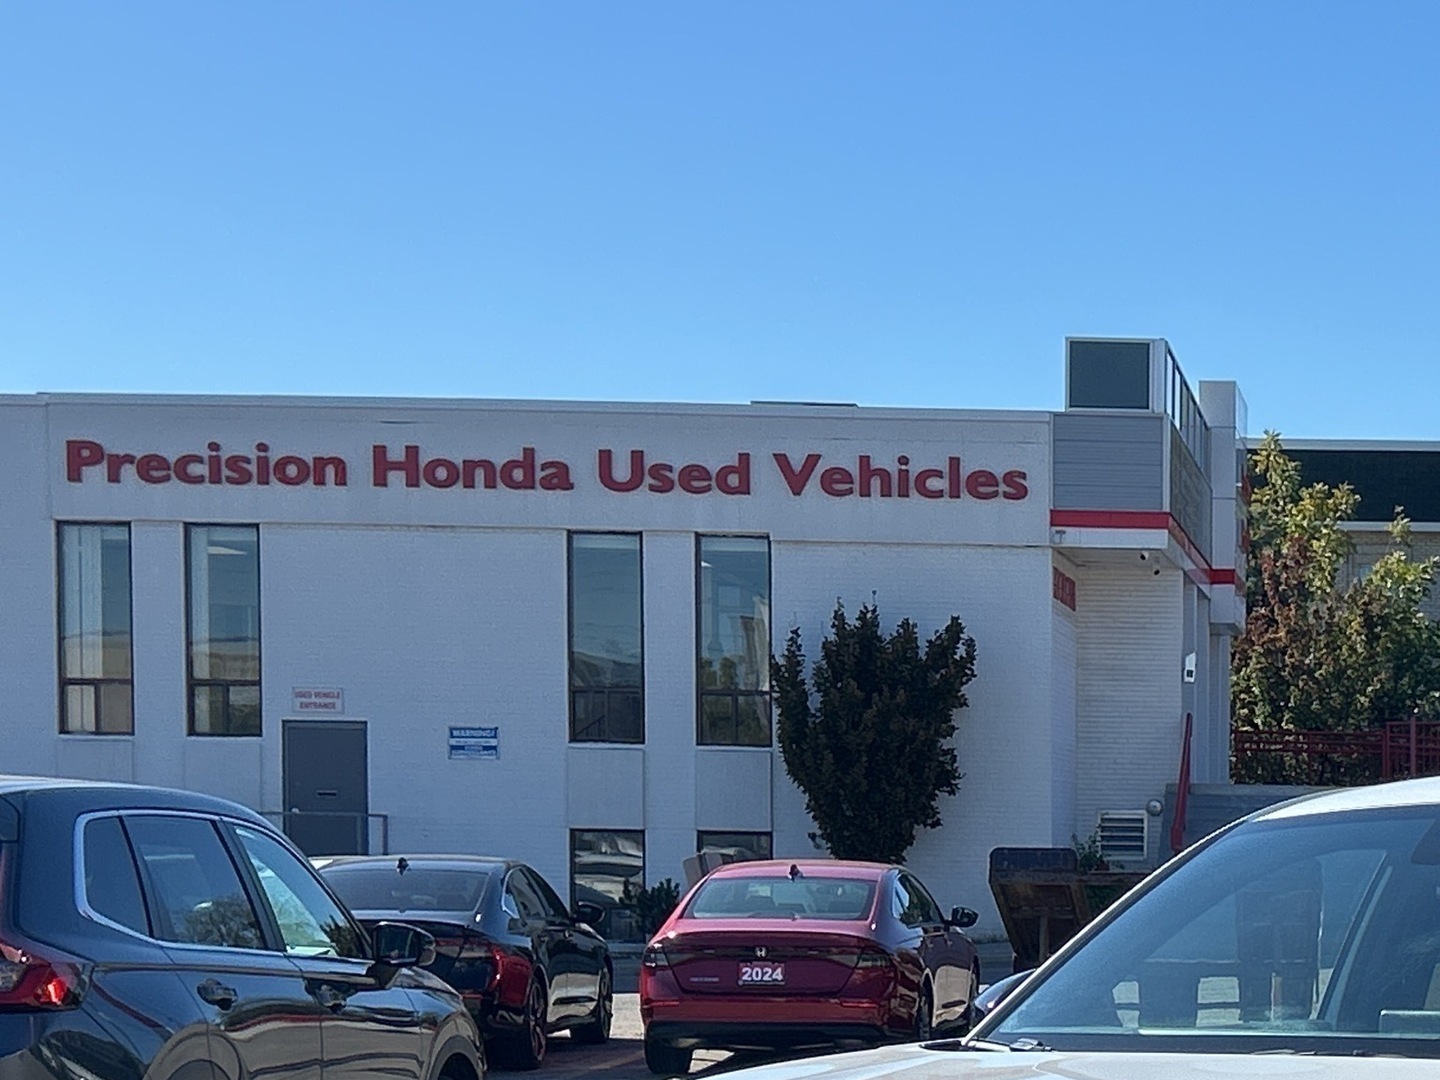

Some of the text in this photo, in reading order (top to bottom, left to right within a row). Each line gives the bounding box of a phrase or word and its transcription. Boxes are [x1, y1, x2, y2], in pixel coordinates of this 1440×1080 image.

[66, 440, 1029, 501] Precision Honda Used Vehicles
[741, 967, 784, 982] 2024
